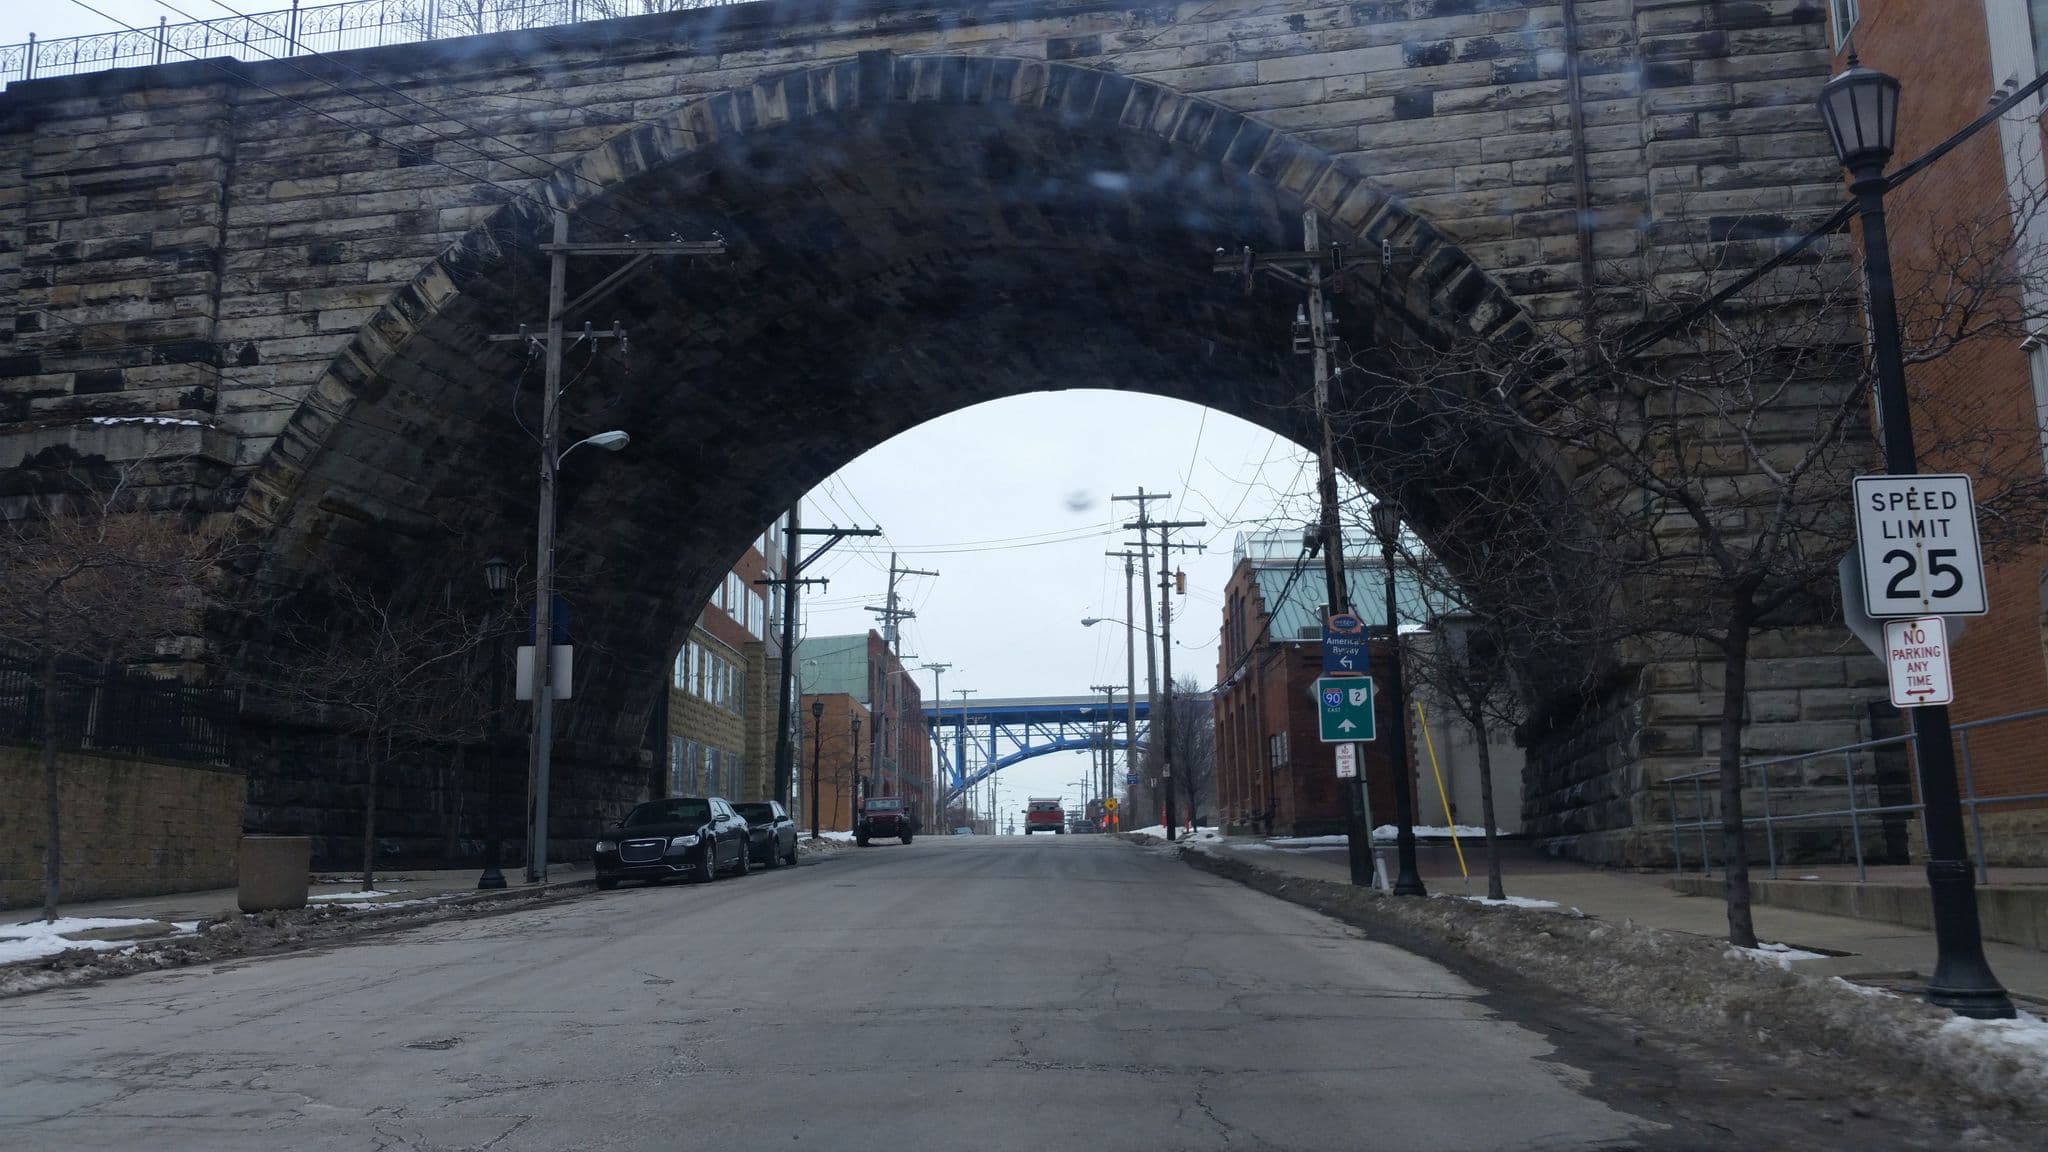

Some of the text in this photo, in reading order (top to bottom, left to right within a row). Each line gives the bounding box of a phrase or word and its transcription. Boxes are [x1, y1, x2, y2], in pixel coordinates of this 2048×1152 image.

[1871, 491, 1957, 512] SPEED
[1882, 519, 1951, 539] LIMIT
[1882, 549, 1964, 599] 25
[1903, 629, 1925, 645] NO
[1332, 646, 1360, 656] Byay
[1892, 645, 1941, 661] PARKING
[1906, 661, 1929, 673] ANY
[1906, 674, 1933, 687] TIME
[1326, 691, 1361, 704] 90 2
